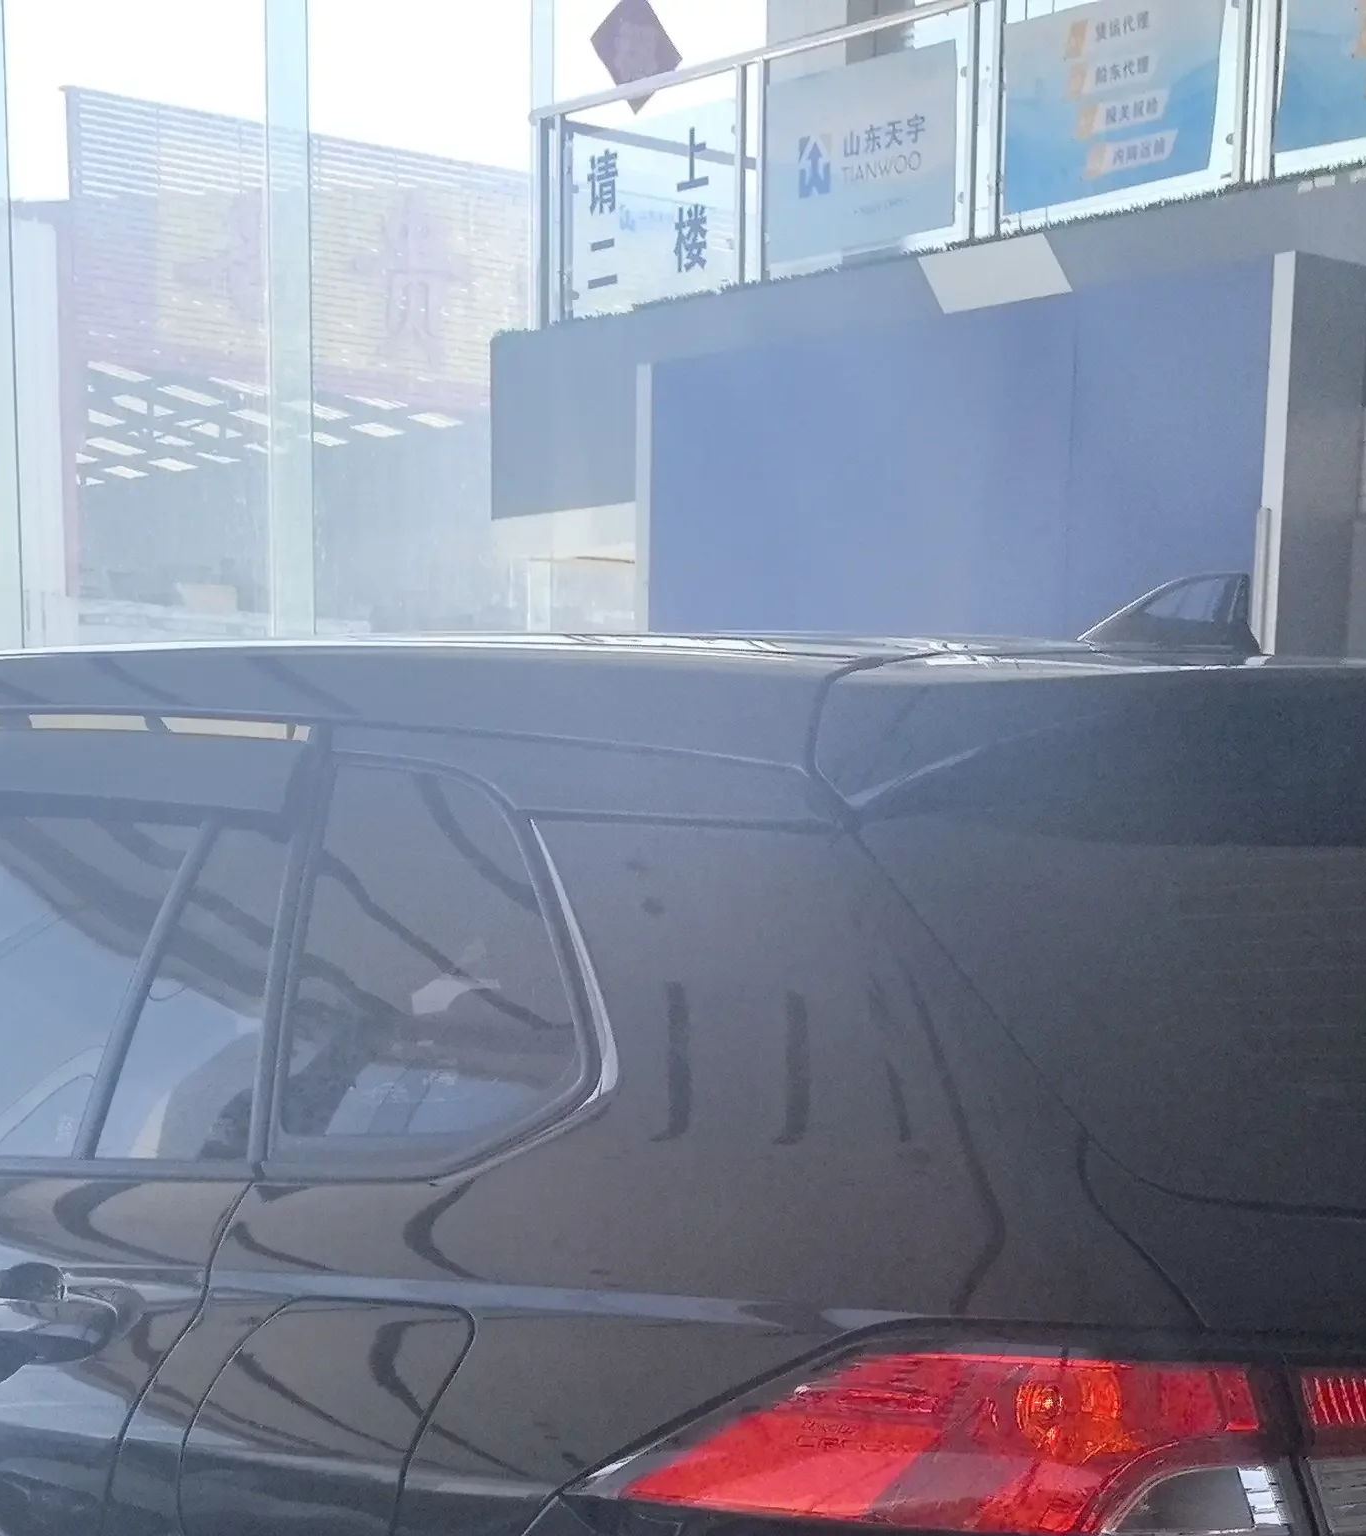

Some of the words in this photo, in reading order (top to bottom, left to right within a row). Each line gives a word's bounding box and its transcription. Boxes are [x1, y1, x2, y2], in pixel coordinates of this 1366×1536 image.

[843, 112, 926, 158] 山东天宇
[841, 150, 922, 188] TIANWOO
